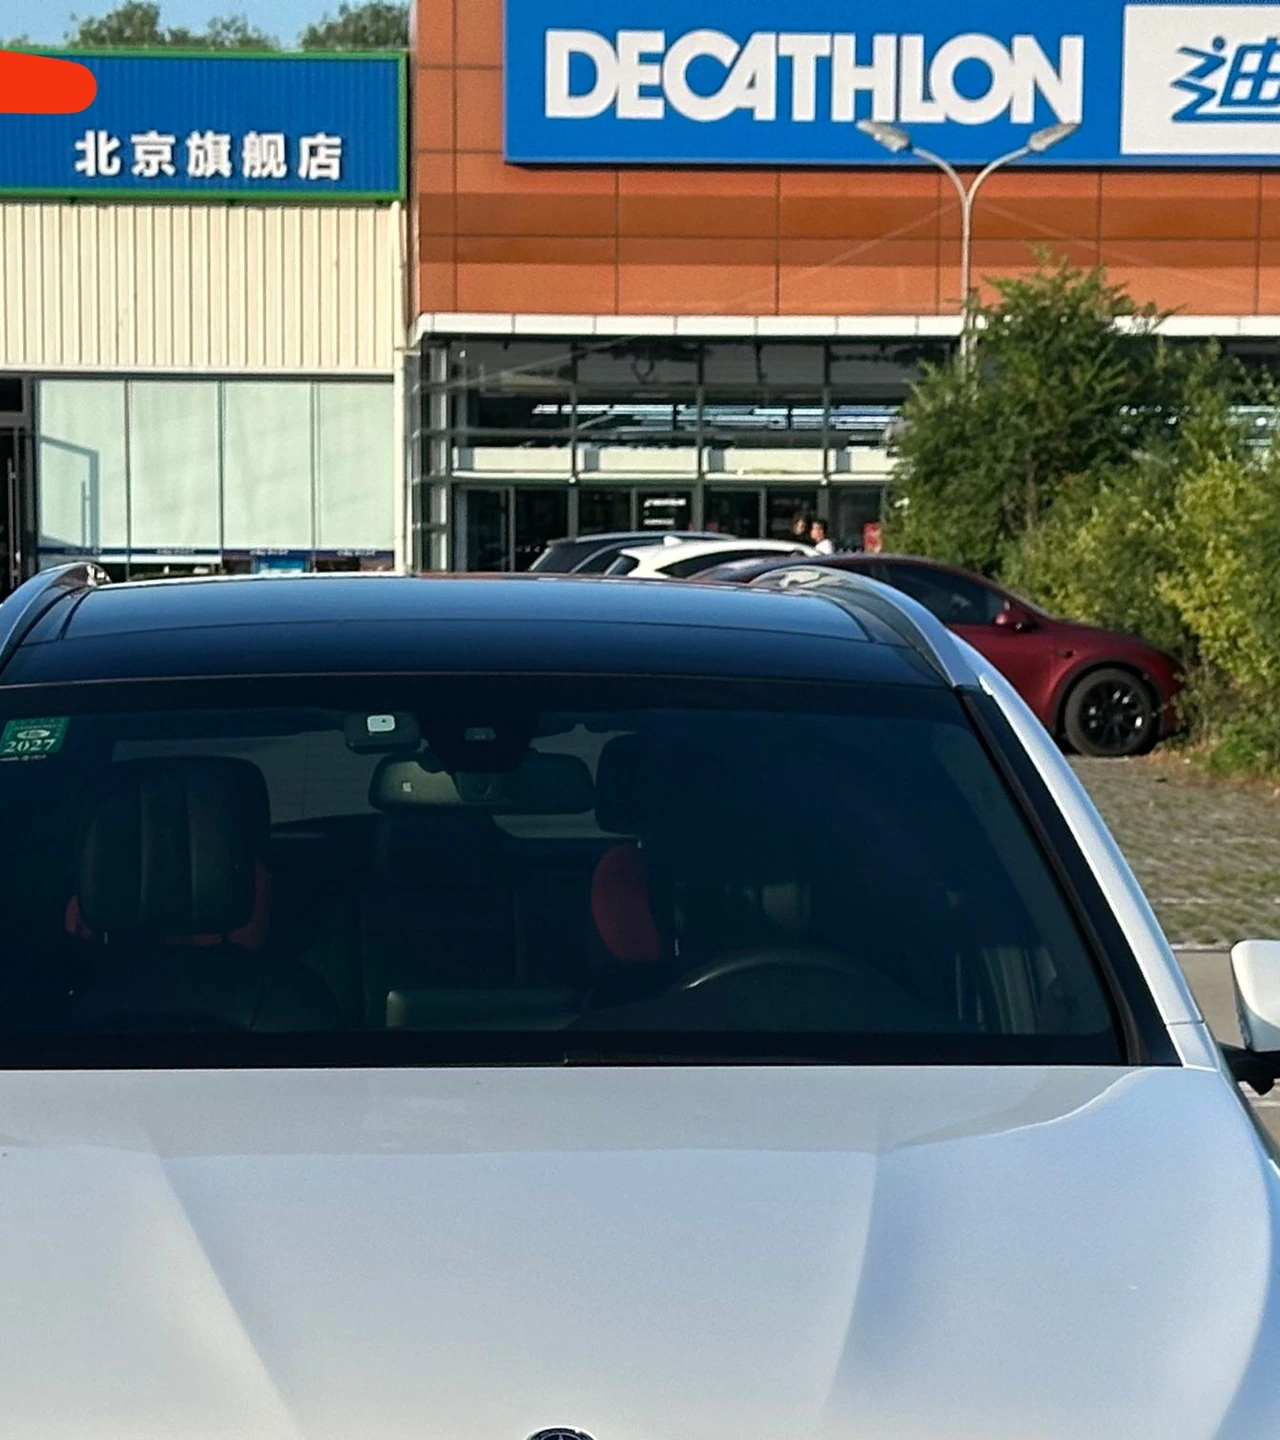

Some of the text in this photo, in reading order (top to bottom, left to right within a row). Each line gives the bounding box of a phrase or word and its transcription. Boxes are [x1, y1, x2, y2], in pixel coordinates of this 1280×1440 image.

[544, 28, 1084, 124] DECATHLON
[74, 129, 343, 180] 北京旗舰店
[3, 738, 56, 753] 2027
